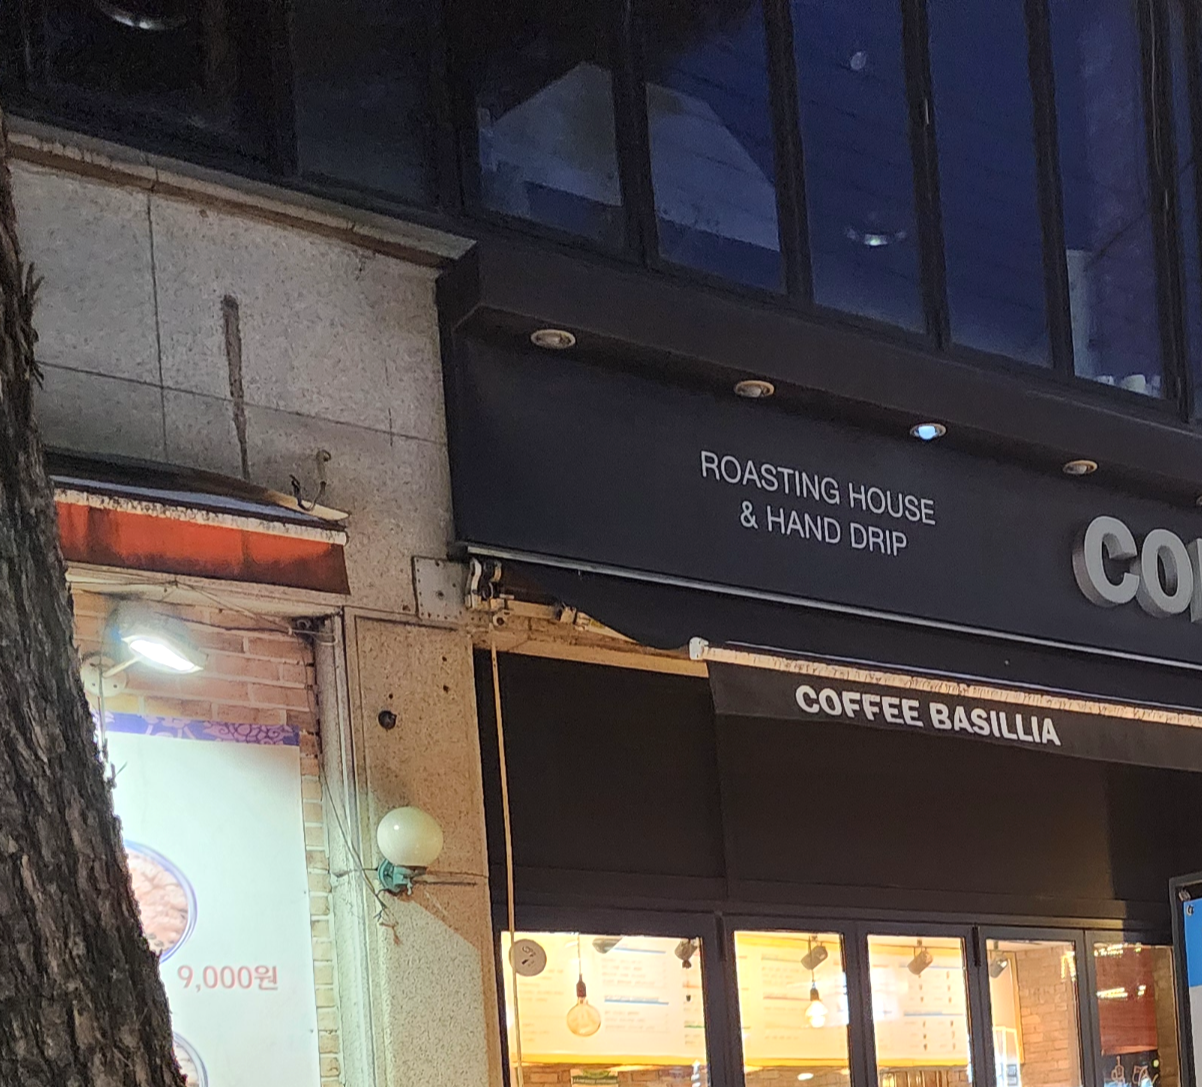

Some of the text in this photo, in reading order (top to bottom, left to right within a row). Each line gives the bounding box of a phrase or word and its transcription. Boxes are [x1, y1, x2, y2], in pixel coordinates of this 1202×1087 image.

[700, 450, 937, 525] ROASTING HOUSE
[740, 501, 908, 556] & HAND DRIP
[795, 684, 1062, 746] COFFEE BASILLIA
[177, 964, 279, 993] 9,000원
